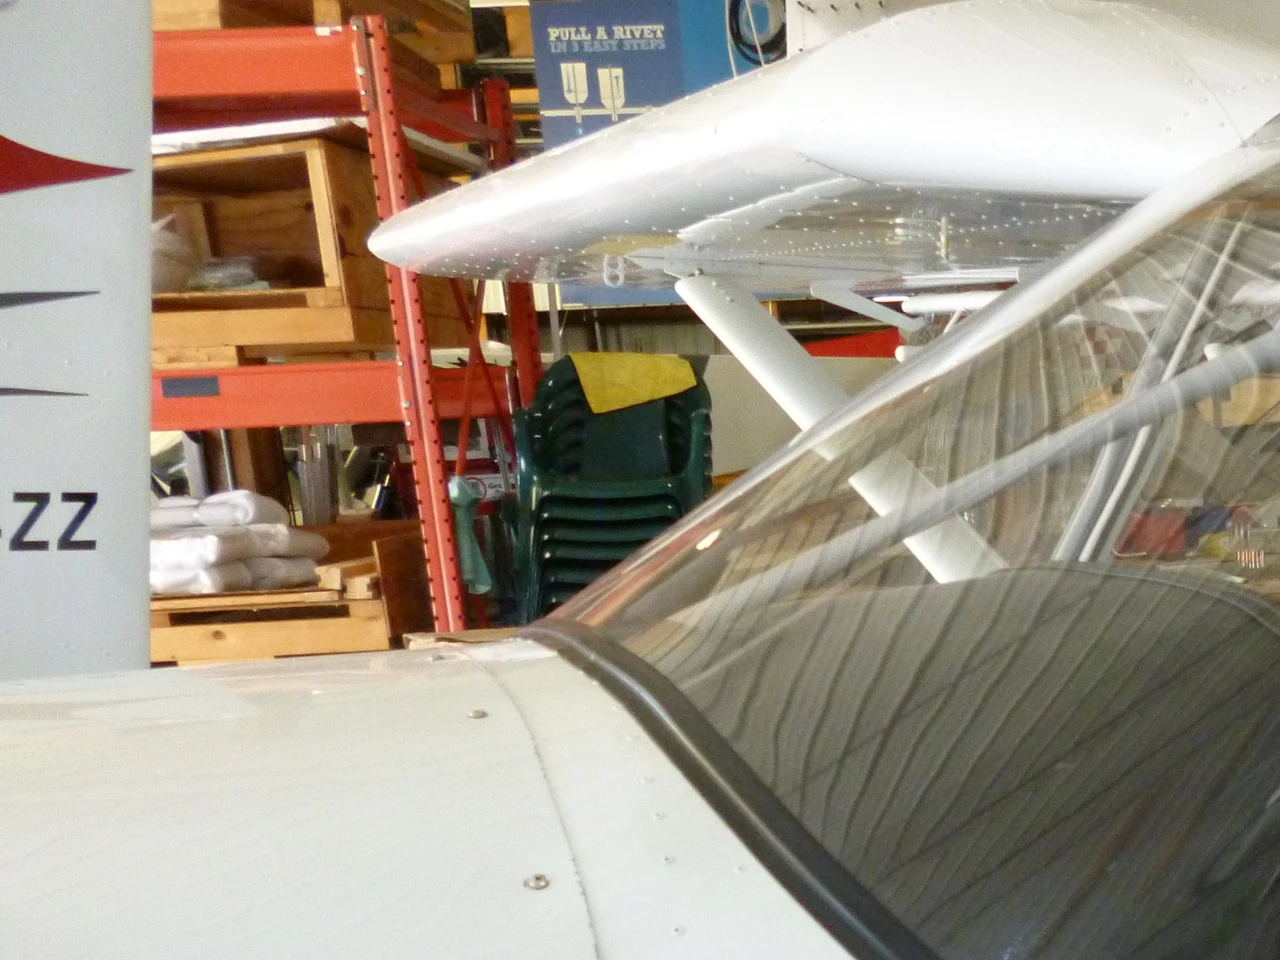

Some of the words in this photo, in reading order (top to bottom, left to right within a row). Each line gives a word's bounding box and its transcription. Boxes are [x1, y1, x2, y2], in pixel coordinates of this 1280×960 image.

[548, 27, 591, 41] PULL
[596, 25, 608, 40] A
[612, 24, 665, 40] RIVET
[550, 41, 567, 53] IN
[571, 41, 579, 52] 3
[584, 40, 618, 52] EASY
[623, 39, 666, 51] STEPS
[0, 491, 98, 551] ZZ
